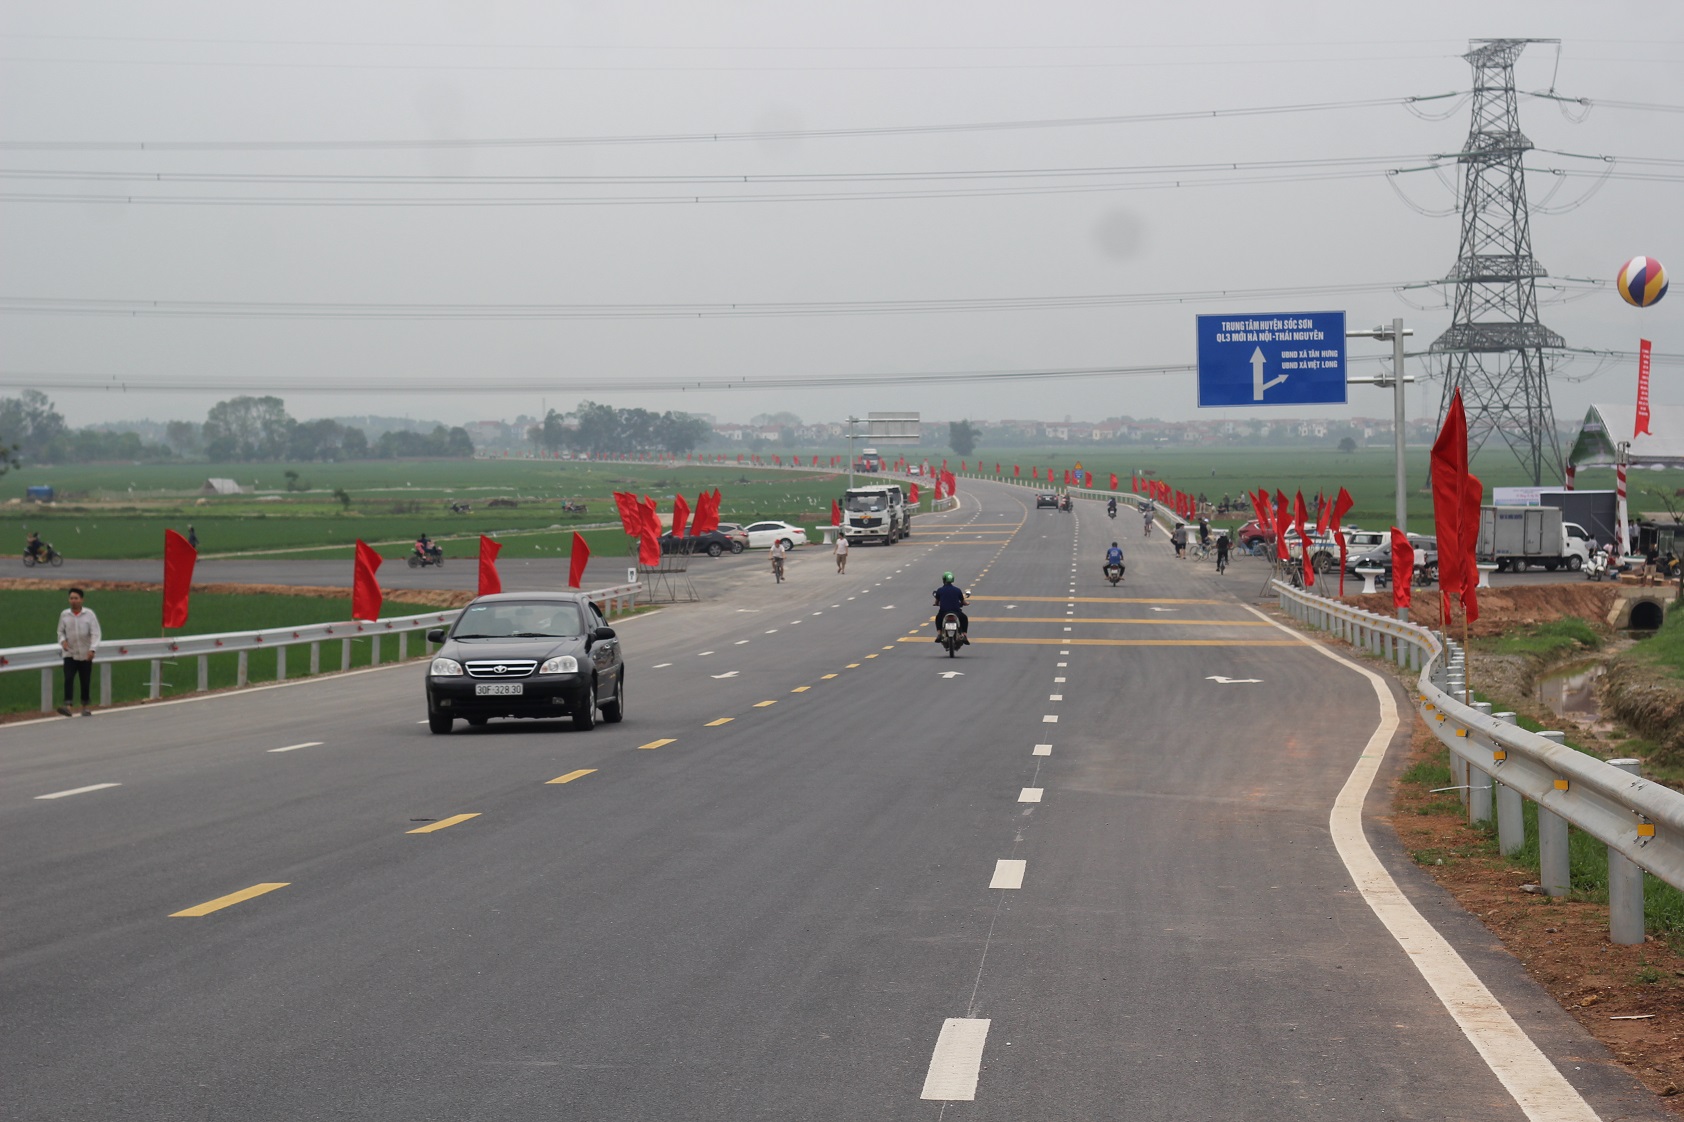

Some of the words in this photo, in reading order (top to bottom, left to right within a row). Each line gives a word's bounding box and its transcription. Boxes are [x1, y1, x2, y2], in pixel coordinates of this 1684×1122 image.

[1222, 321, 1245, 331] TRUNG
[1245, 319, 1259, 330] TÂM
[1260, 318, 1283, 331] HUYỆN
[1283, 317, 1297, 329] SÓC
[1298, 318, 1313, 329] SƠN
[1216, 333, 1231, 343] QL3
[1231, 331, 1246, 342] MỚI
[1247, 331, 1258, 341] HÀ
[1293, 329, 1324, 341] NGUYÊN
[1281, 350, 1298, 358] UBND
[1308, 349, 1320, 358] TÂN
[1281, 361, 1298, 369] UBND
[1308, 359, 1320, 370] VIỆT
[1321, 360, 1338, 368] LONG
